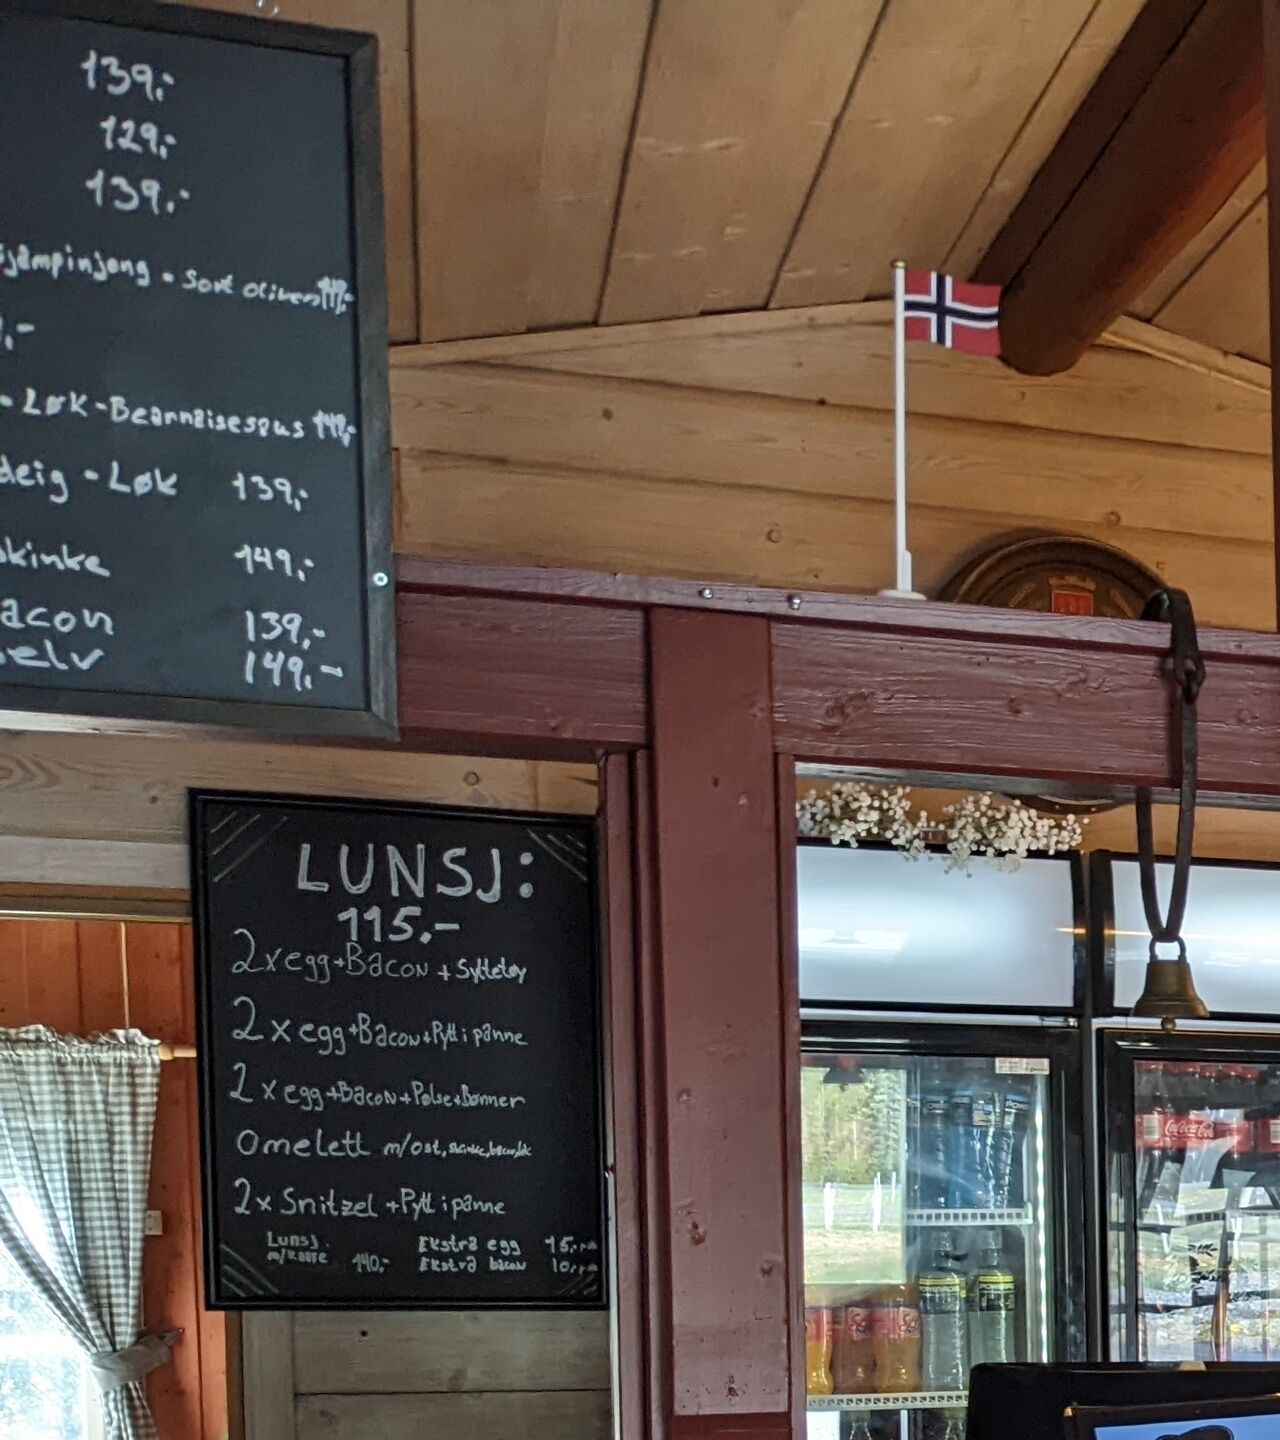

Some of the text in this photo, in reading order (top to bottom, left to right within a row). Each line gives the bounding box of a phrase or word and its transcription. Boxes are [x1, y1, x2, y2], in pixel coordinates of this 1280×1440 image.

[236, 1128, 371, 1157] Omelett
[279, 1187, 379, 1218] Snitzel
[487, 1239, 521, 1255] egg
